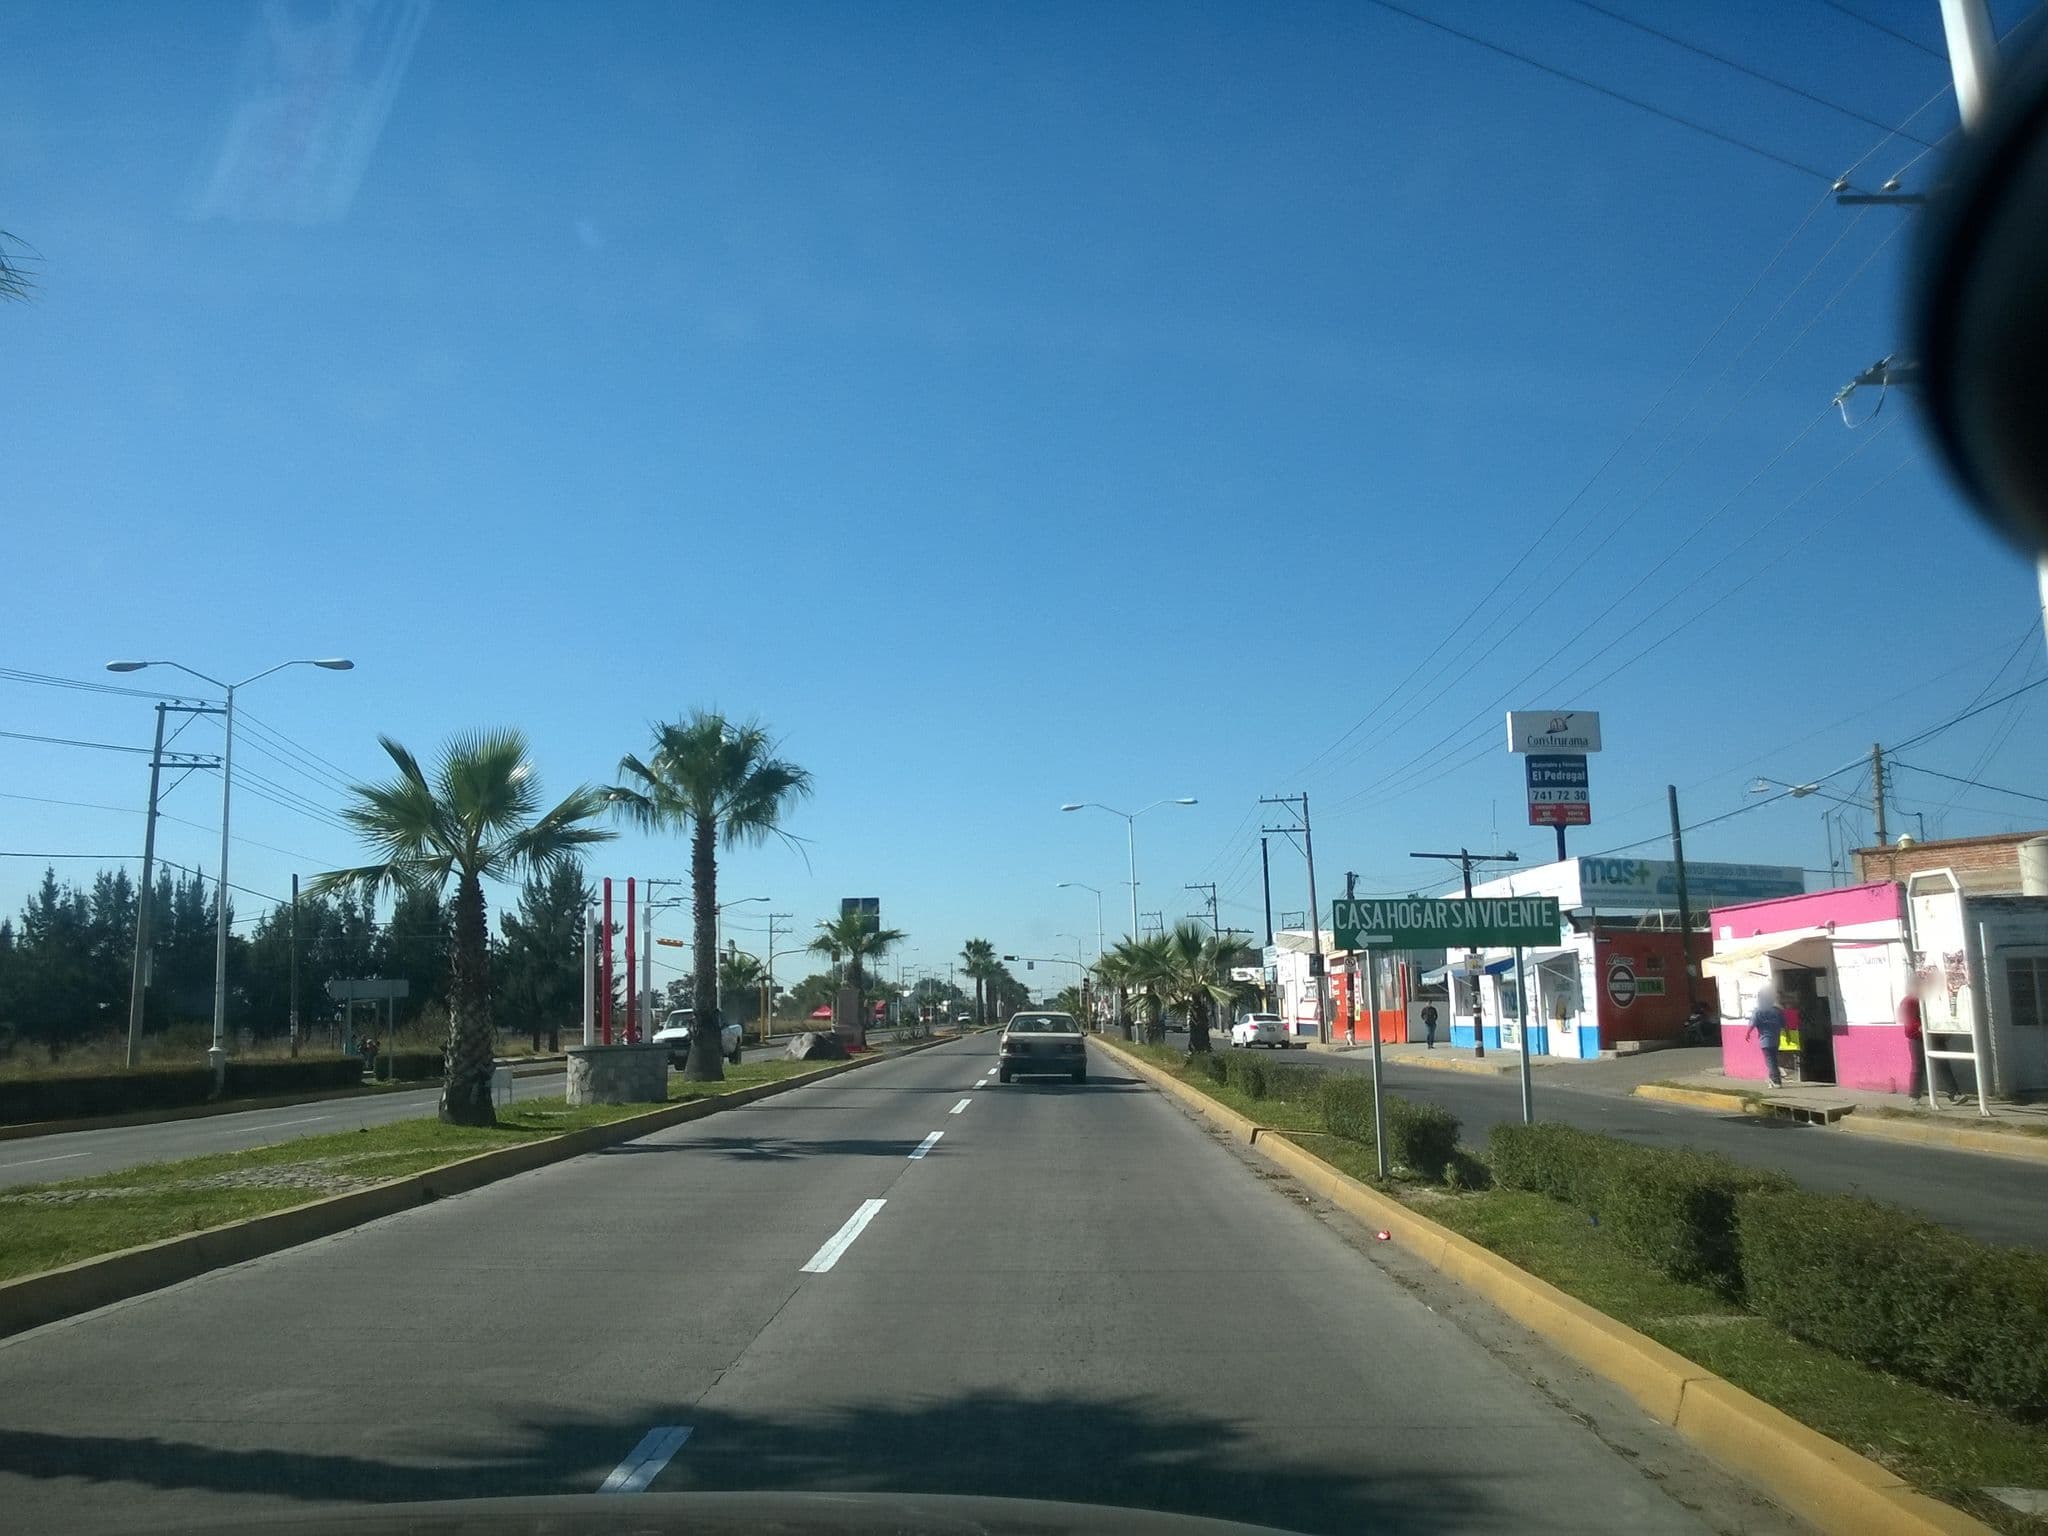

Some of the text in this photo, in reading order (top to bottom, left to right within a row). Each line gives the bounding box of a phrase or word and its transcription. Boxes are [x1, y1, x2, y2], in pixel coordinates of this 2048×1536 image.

[1527, 735, 1589, 747] Construrama
[1532, 790, 1587, 801] 741 72 30
